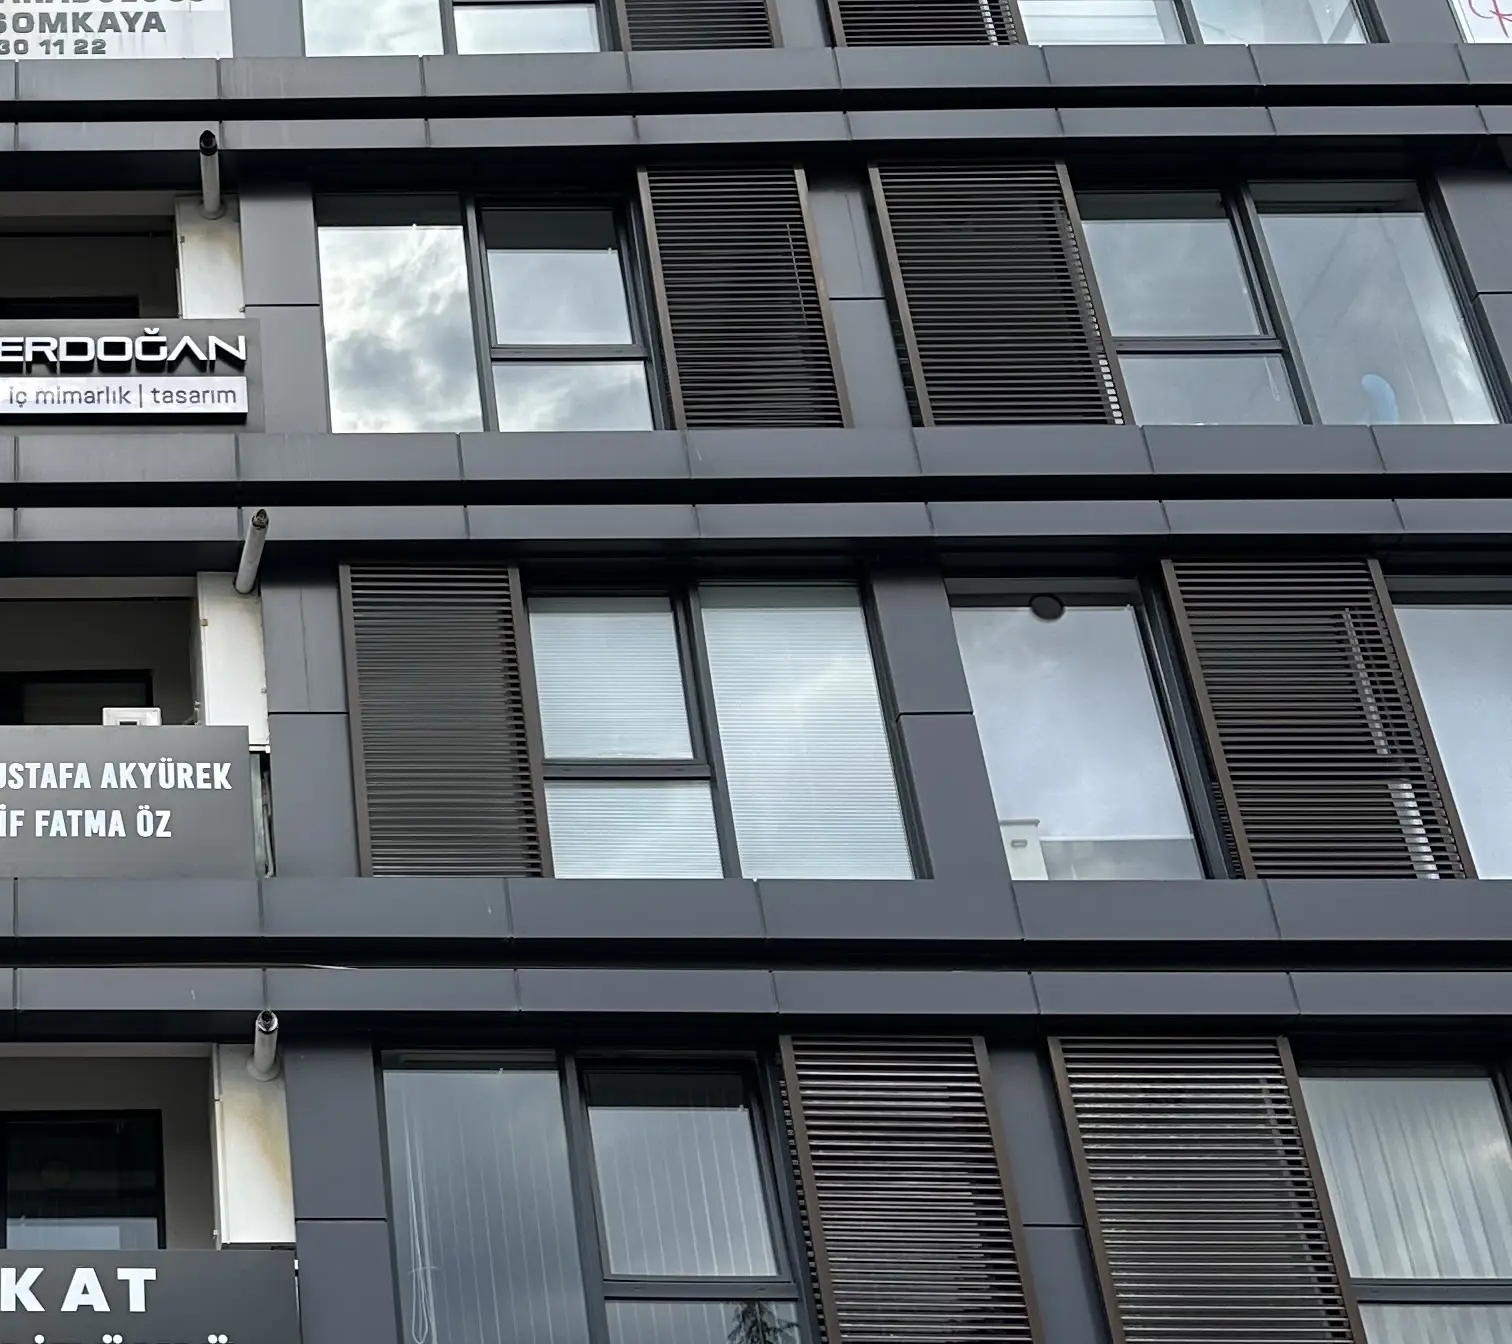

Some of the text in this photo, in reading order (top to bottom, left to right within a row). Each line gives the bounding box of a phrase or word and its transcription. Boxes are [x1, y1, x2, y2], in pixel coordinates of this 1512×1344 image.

[39, 39, 65, 55] 11
[74, 38, 107, 55] 22
[8, 386, 238, 408] iç mimarlık tasarım
[101, 757, 232, 790] AKYÜREK
[35, 809, 126, 838] FATMA
[136, 805, 172, 838] ÖZ
